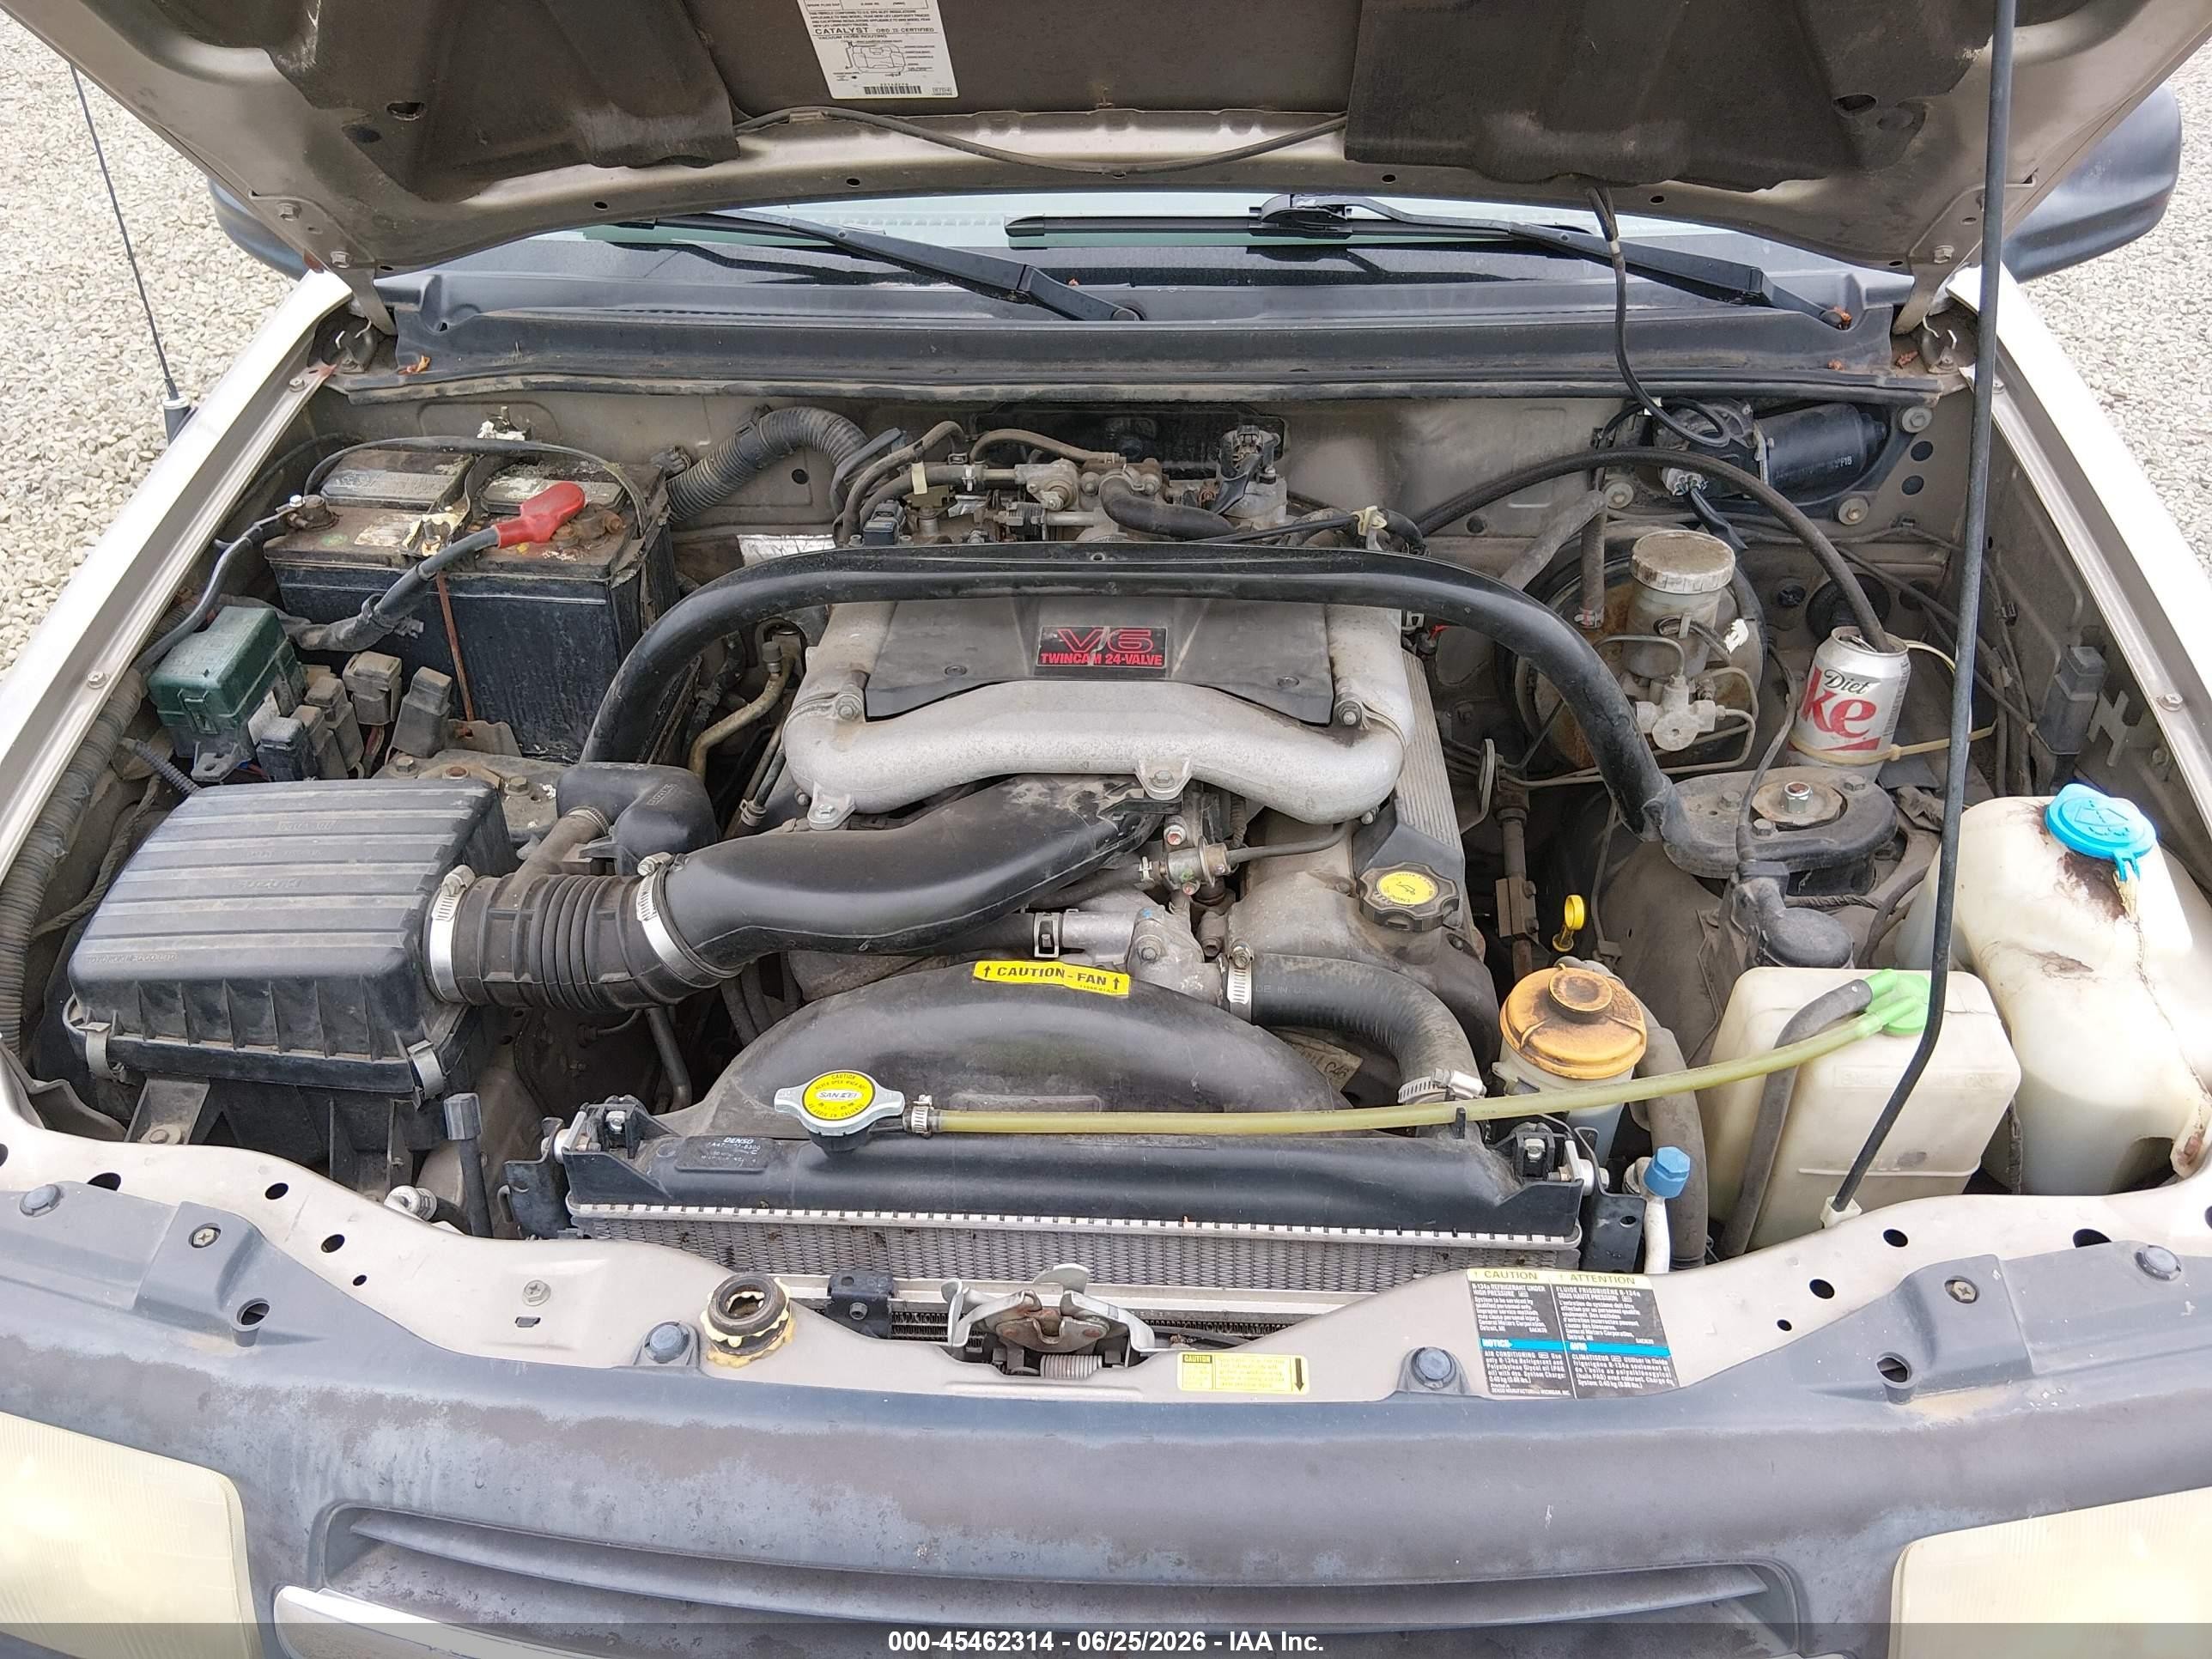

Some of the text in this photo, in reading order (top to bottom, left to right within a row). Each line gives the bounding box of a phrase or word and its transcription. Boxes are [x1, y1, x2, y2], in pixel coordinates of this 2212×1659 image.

[1057, 629, 1154, 653] V6
[1041, 653, 1163, 665] TWINCAM 24-VALVE
[1824, 669, 1869, 695] Diet
[997, 967, 1065, 978] CAUTION
[1077, 973, 1107, 985] FAN
[1485, 1271, 1537, 1279] CAUTION
[1571, 1274, 1635, 1285] ATTENTION
